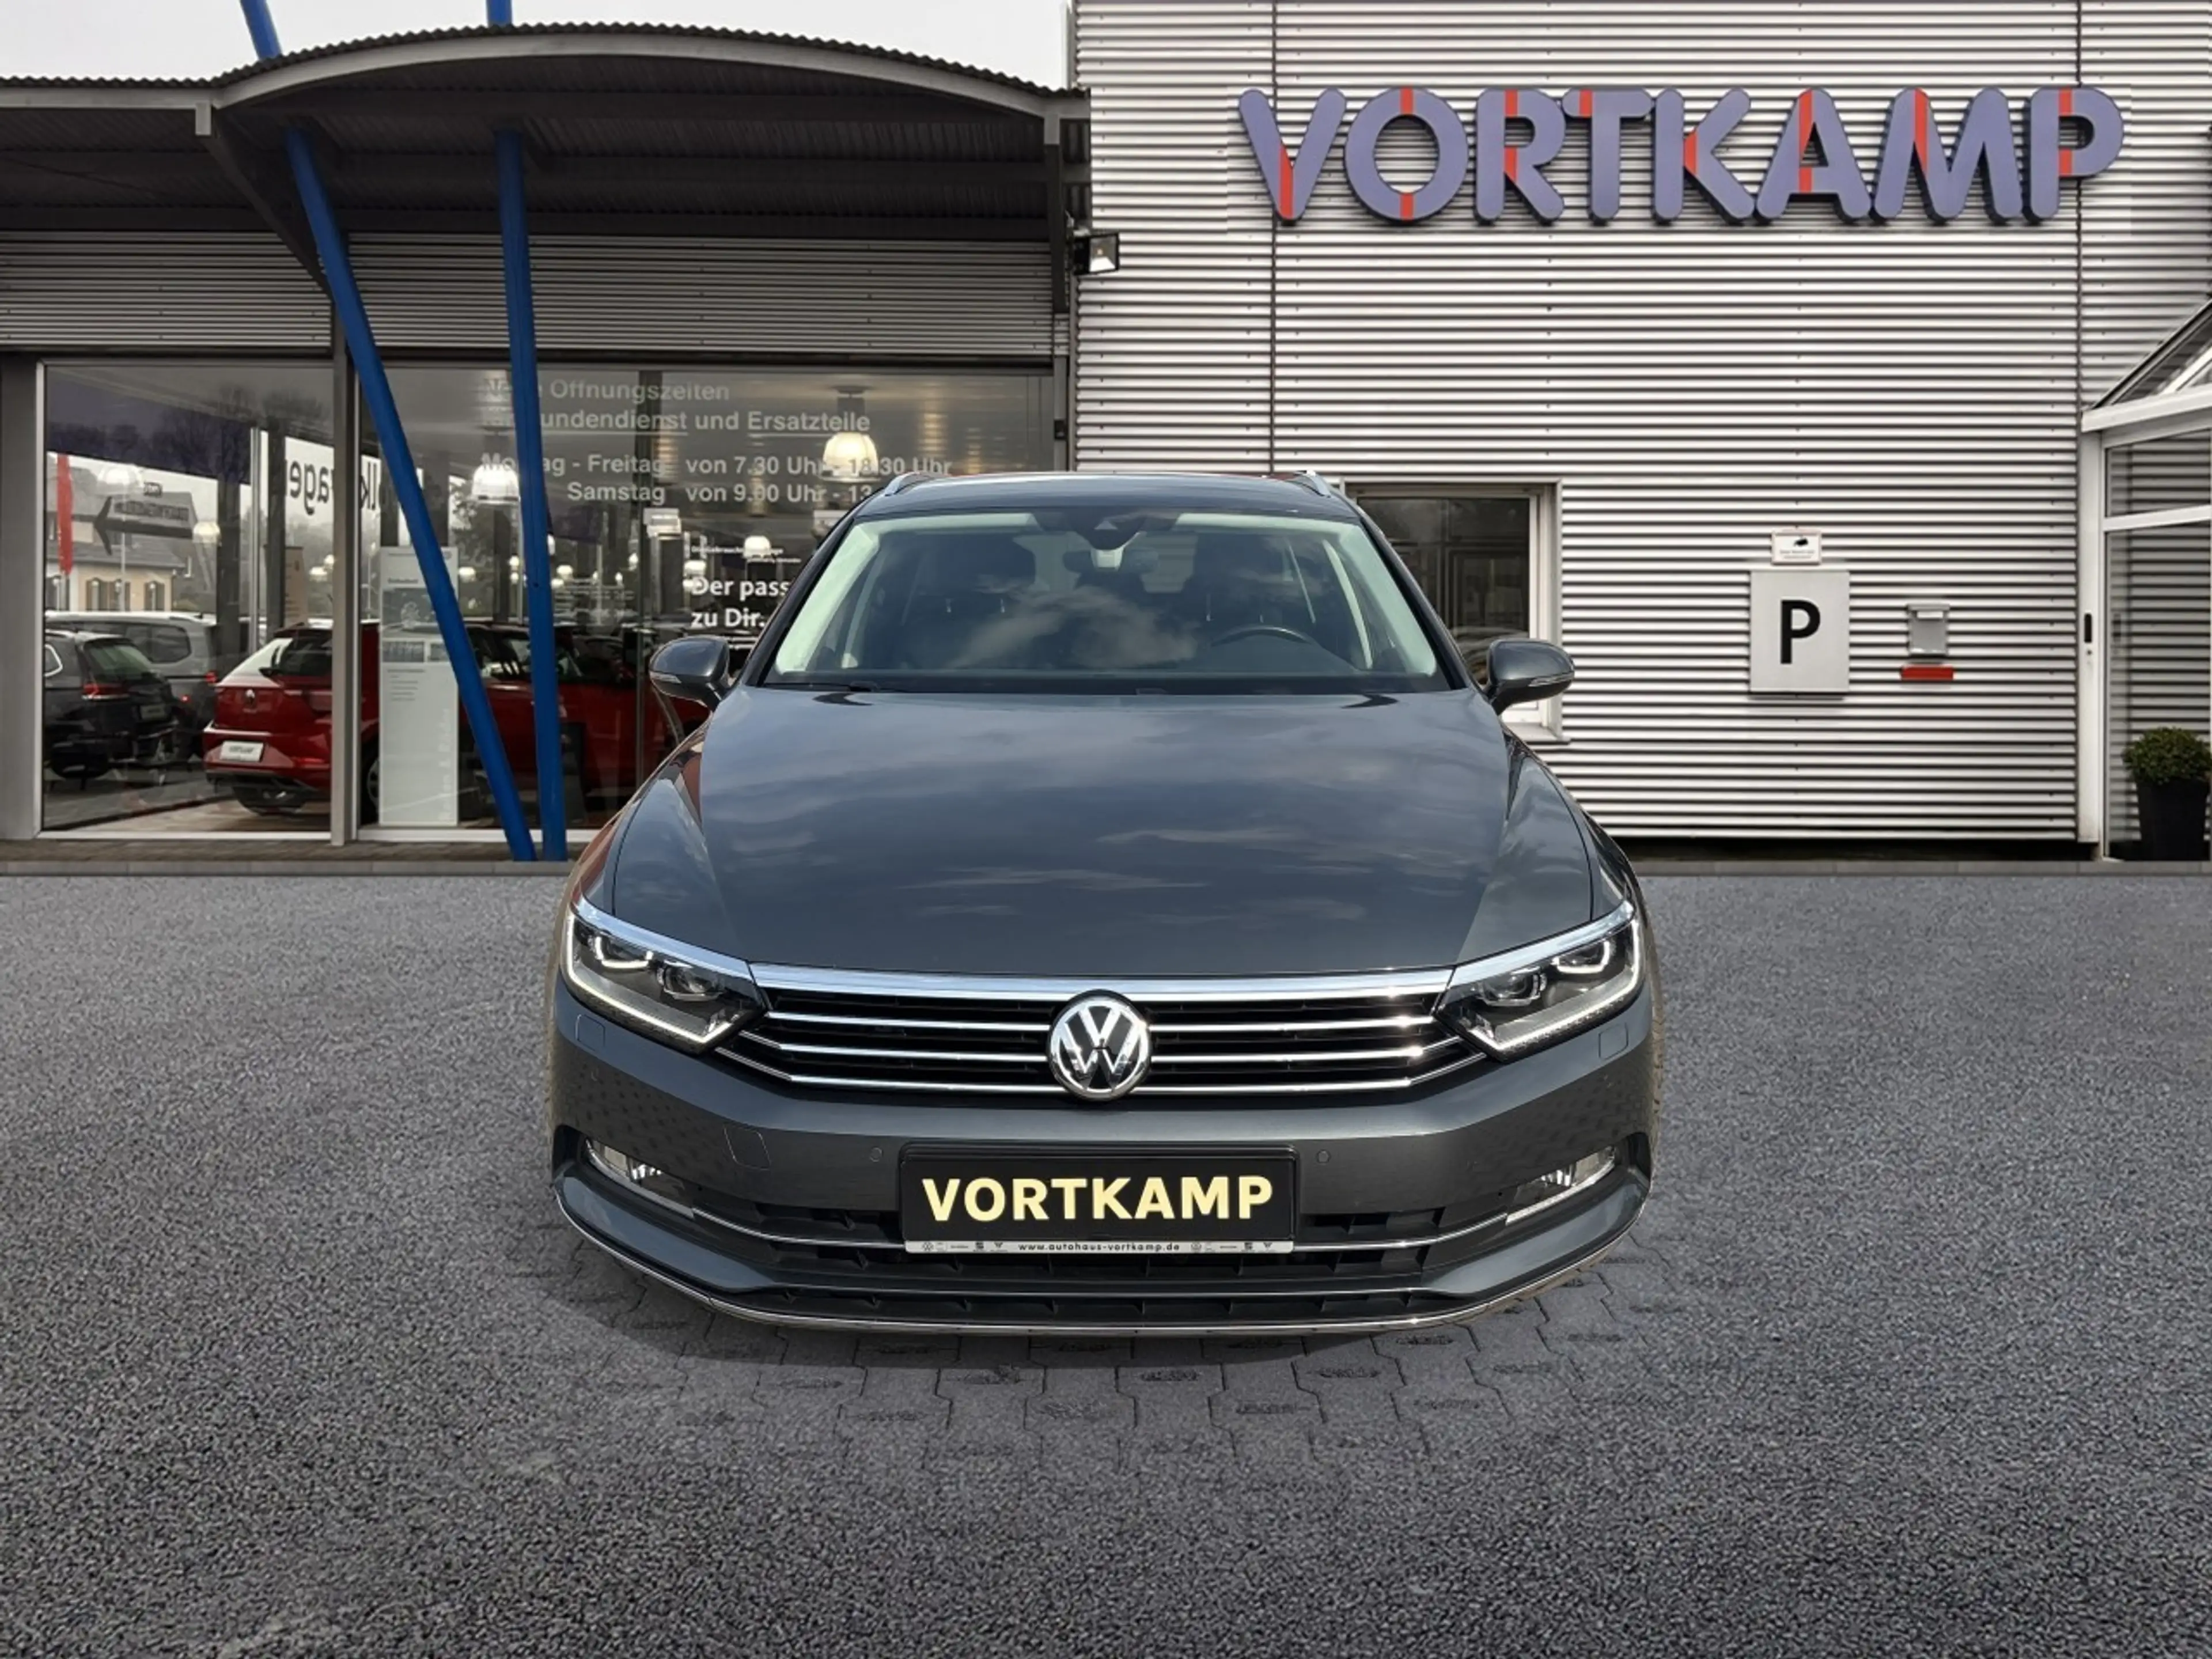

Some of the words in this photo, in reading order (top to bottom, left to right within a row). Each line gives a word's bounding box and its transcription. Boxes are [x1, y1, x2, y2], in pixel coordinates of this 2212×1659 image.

[1238, 85, 2124, 222] VORTKAMP
[541, 409, 687, 430] undendienst
[694, 411, 739, 430] und
[748, 411, 870, 431] Ersatzteile
[482, 452, 566, 477] Moag
[588, 454, 664, 478] Freitag
[685, 459, 727, 474] von
[787, 456, 824, 475] Uhr
[567, 482, 665, 505] Samstag
[685, 486, 727, 502] von
[787, 484, 826, 502] Uhr
[692, 577, 734, 596] Der
[692, 612, 718, 627] zu
[724, 607, 766, 627] Dir.
[1780, 599, 1821, 665] P
[922, 1176, 1274, 1222] VORTKAMP
[1017, 1241, 1180, 1252] www.autohaus-vortkamp.de
